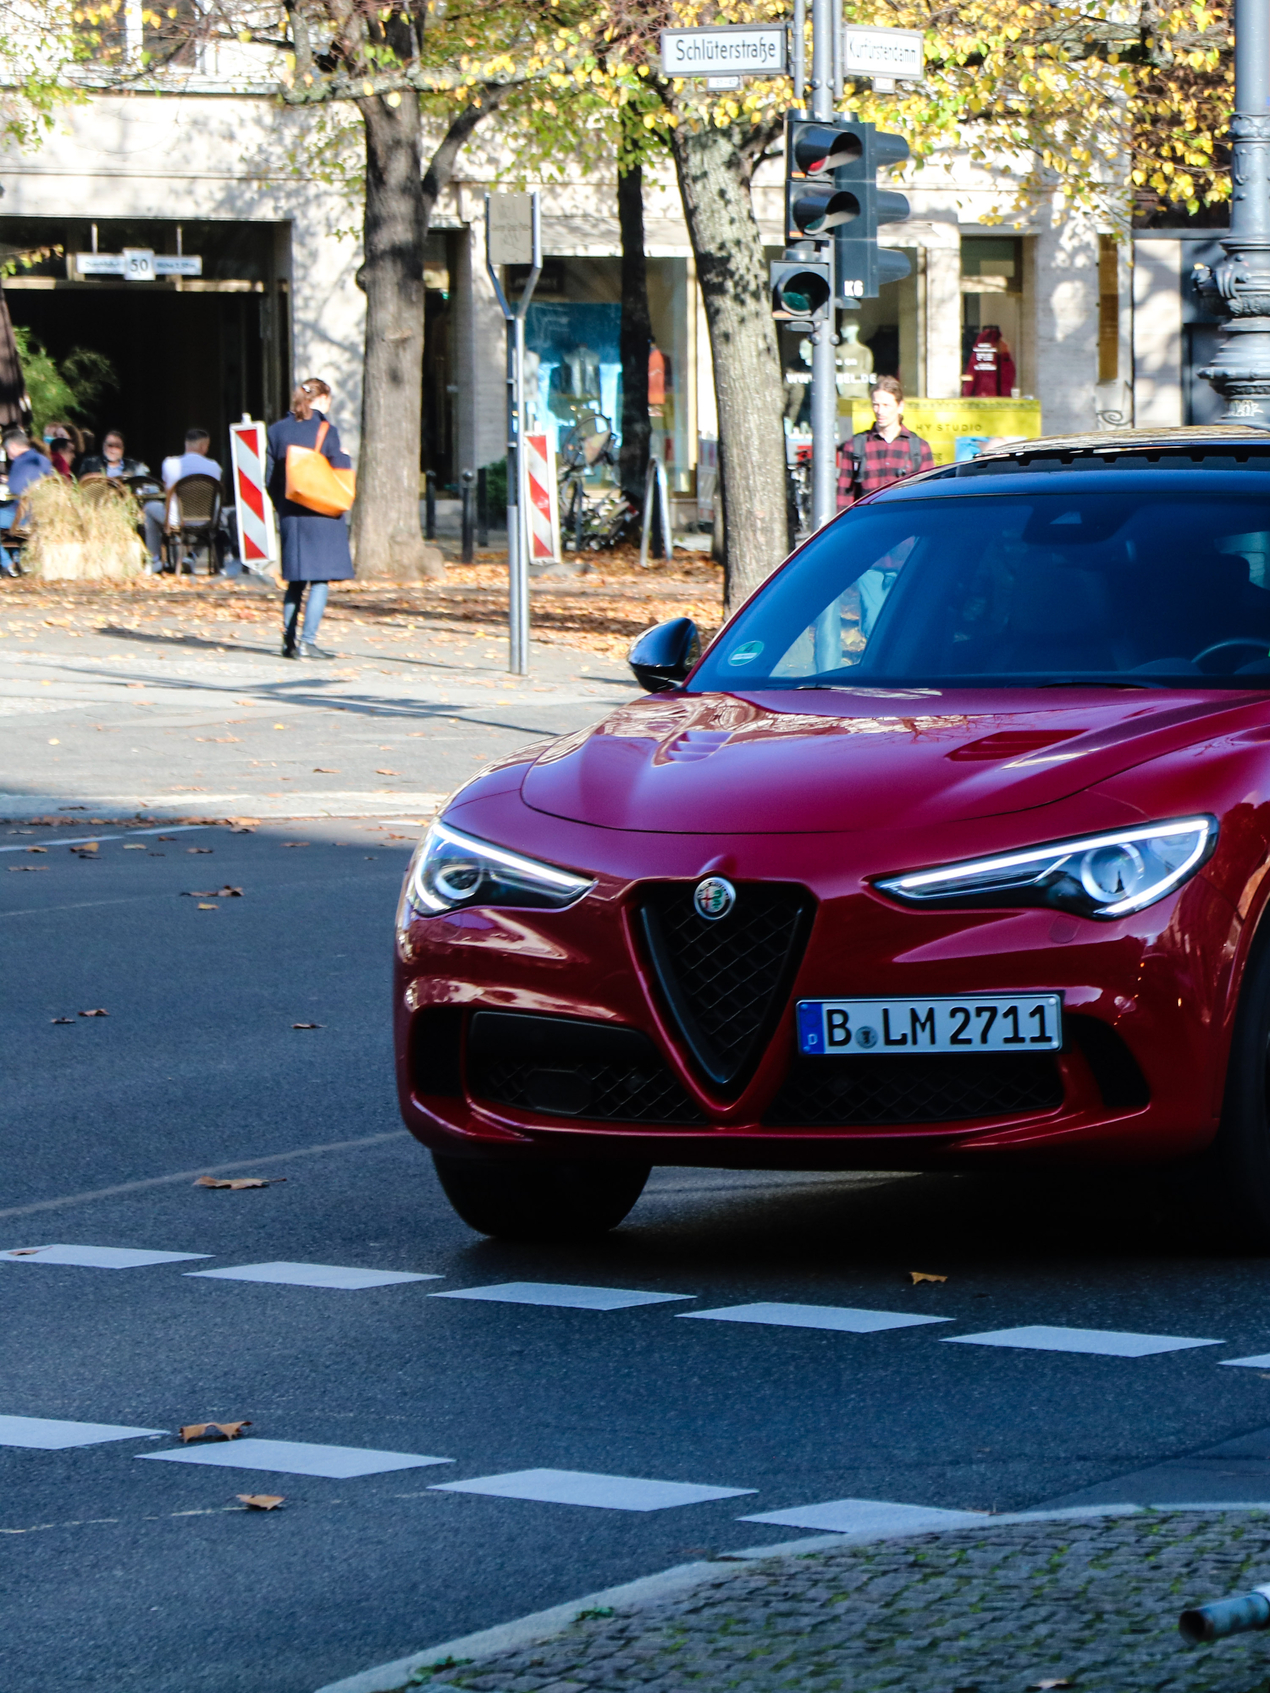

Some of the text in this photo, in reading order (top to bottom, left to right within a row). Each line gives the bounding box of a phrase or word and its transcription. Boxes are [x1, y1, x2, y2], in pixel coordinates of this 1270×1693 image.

[675, 36, 776, 64] Schlüterstraße
[848, 36, 917, 63] Kurfürstendamm
[129, 259, 149, 272] 50
[844, 280, 864, 297] K6
[936, 424, 982, 432] STUDIO
[807, 1004, 1054, 1047] D B LM 2711
